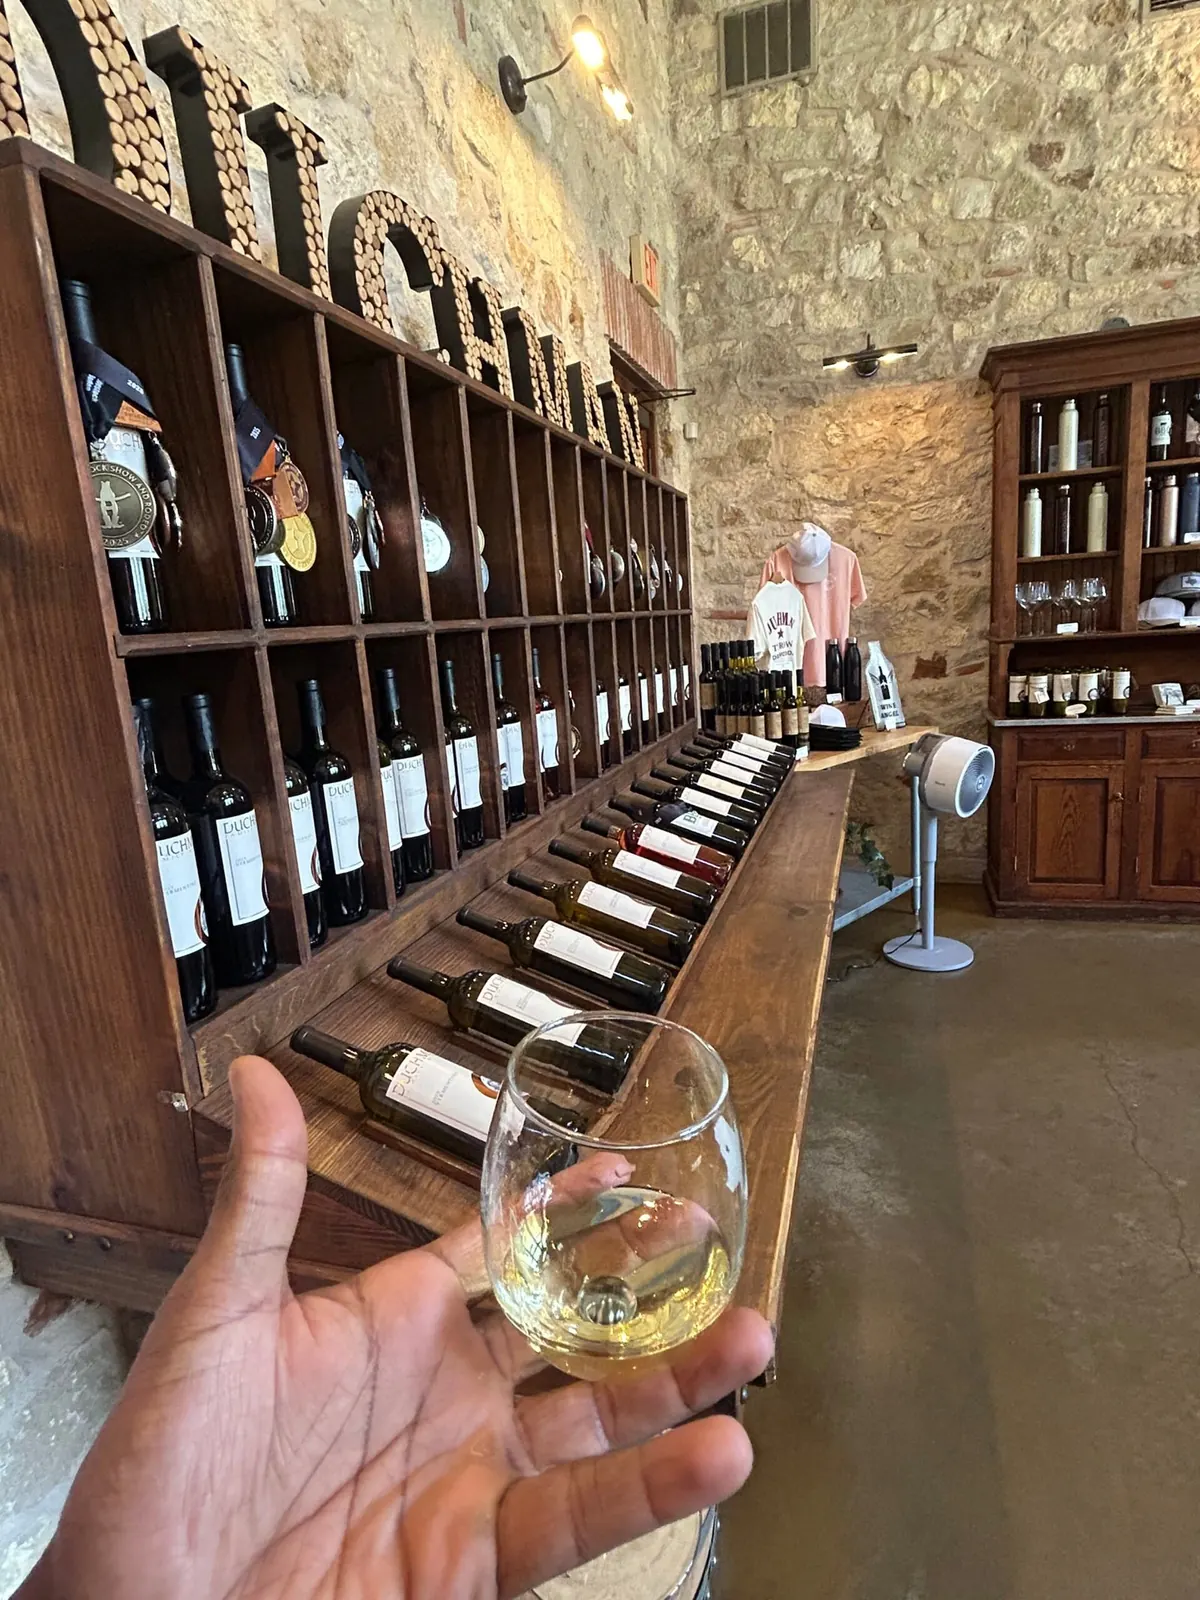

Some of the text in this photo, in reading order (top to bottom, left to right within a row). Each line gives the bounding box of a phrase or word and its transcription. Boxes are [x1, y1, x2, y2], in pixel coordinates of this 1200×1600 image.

[110, 465, 137, 482] SHOW
[135, 482, 150, 501] AND
[140, 501, 154, 536] RODEO
